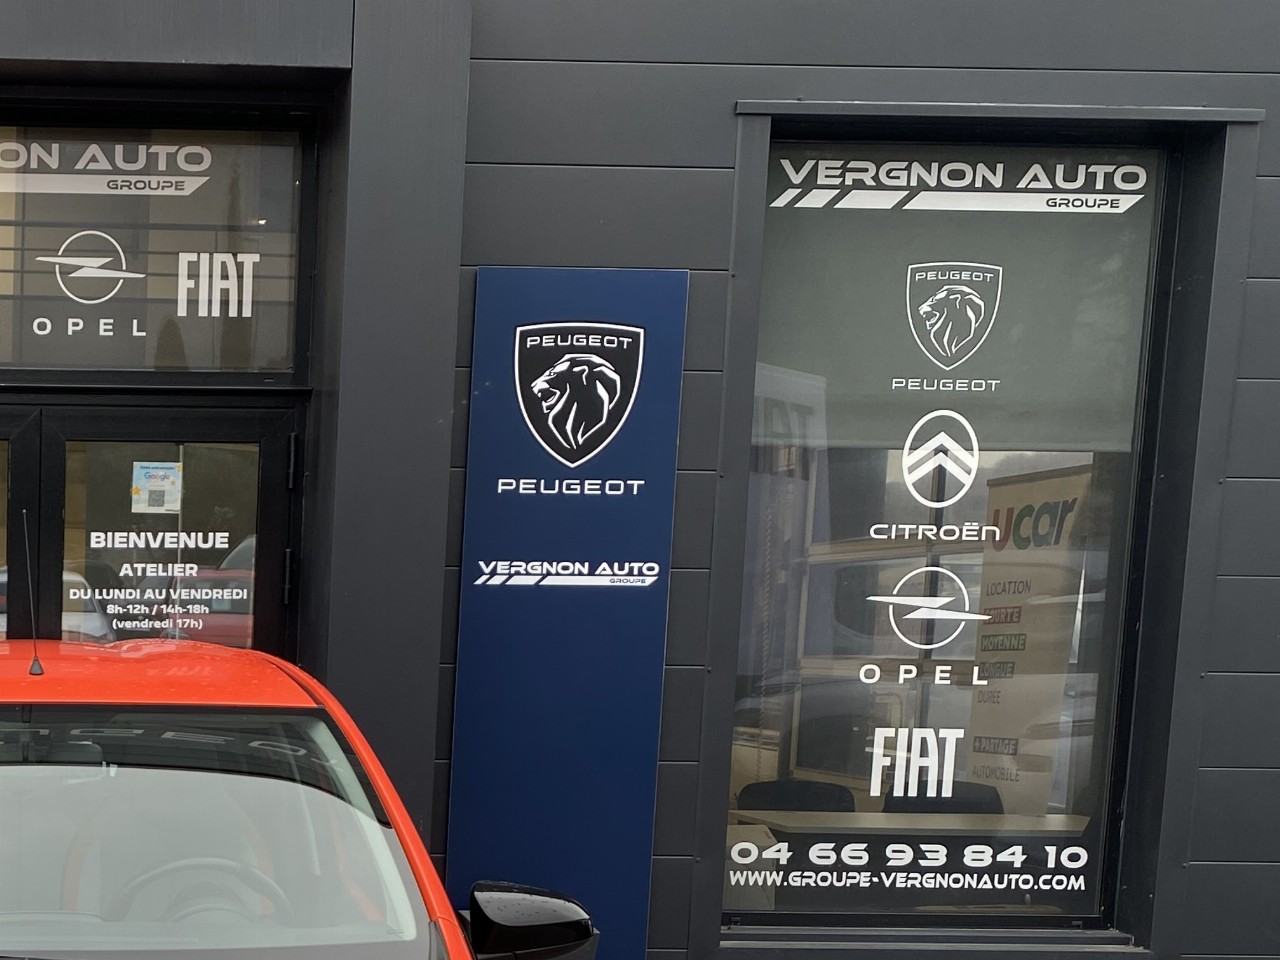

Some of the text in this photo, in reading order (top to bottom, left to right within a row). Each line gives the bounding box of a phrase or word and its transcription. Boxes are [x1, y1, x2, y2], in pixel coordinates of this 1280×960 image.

[74, 143, 213, 172] AUTO
[779, 158, 1147, 191] VERGNON AUTO
[106, 178, 186, 192] GROUPE
[1045, 197, 1121, 209] GROUPE
[177, 252, 260, 317] FIAT
[915, 270, 994, 283] PEUGEOT
[32, 317, 147, 337] OPEL
[526, 334, 632, 349] PEUGEOT
[891, 378, 1001, 392] PEUGEOT
[497, 479, 645, 495] PEUGEOT
[89, 531, 230, 549] BIENVENUE
[119, 563, 199, 577] ATELIER
[478, 561, 660, 576] VERGNON AUTO
[69, 588, 248, 600] DU LUNDI AU VENDREDI
[986, 580, 1032, 596] LOCATION
[106, 604, 150, 615] 8h-12h
[160, 604, 210, 615] 14h-18h
[112, 618, 204, 630] (vendredi 17h)
[982, 635, 1025, 651] MOYENNE
[859, 664, 989, 685] OPEL
[980, 662, 1014, 677] LONGUE
[870, 727, 964, 797] FIAT
[972, 765, 1020, 782] AUTOMOBILE
[730, 842, 1088, 869] 04 66 93 84 10
[729, 870, 1086, 890] WWW.GROUPE-VERGNONAUTO.COM
